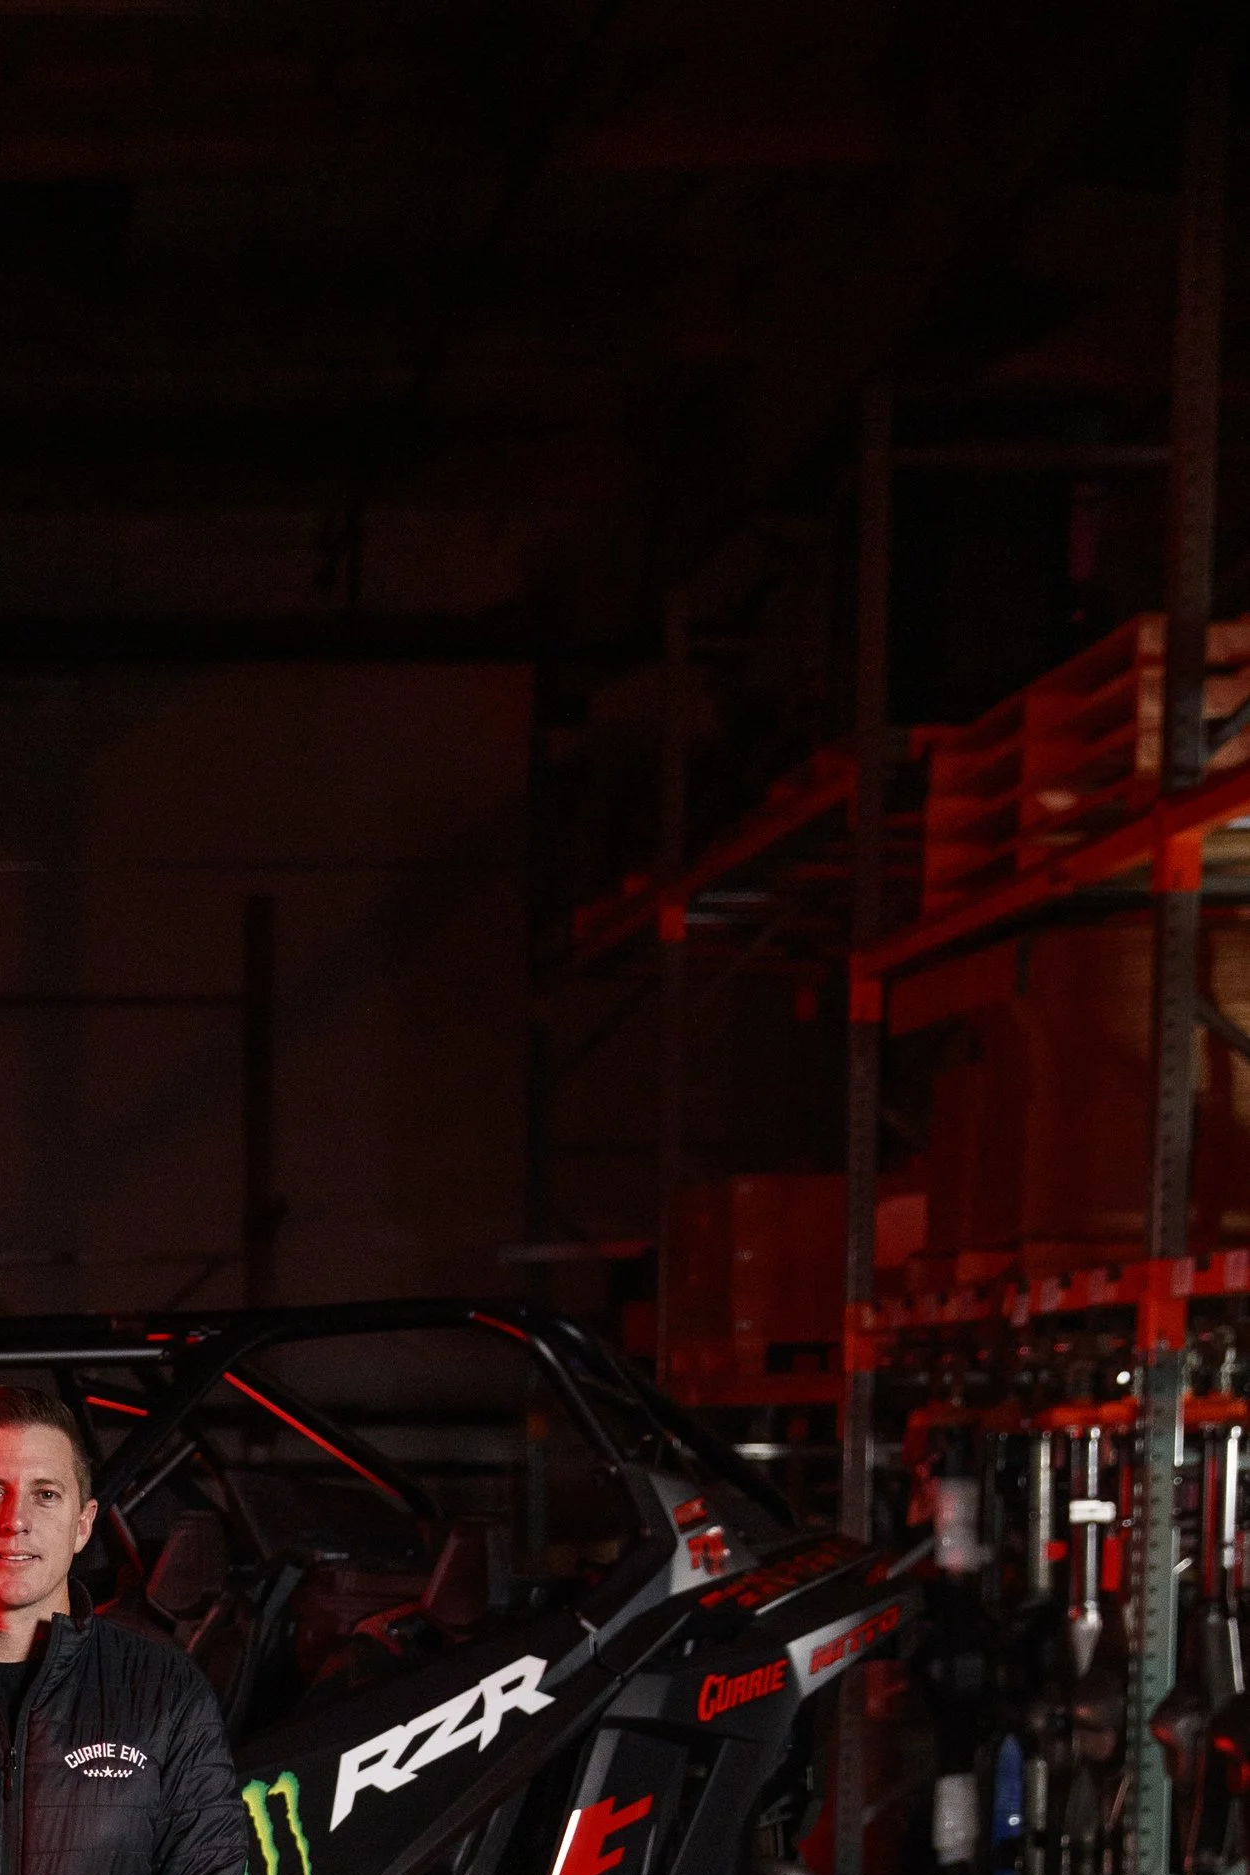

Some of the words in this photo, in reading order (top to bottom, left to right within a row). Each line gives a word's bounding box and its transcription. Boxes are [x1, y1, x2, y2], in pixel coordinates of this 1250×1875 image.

[64, 1743, 116, 1769] CURRIE
[120, 1745, 148, 1769] ENT.
[329, 1655, 556, 1833] RZR
